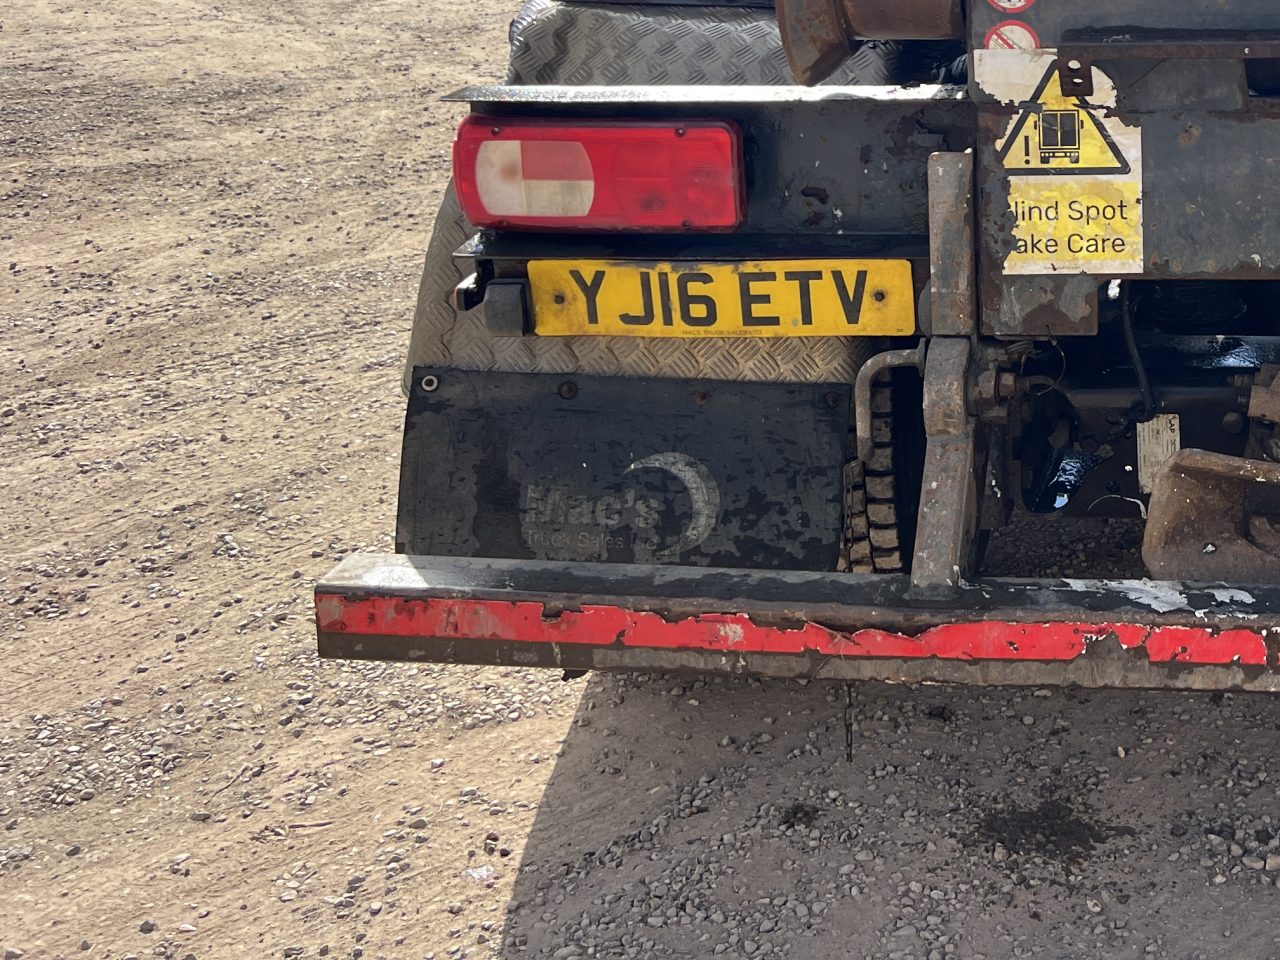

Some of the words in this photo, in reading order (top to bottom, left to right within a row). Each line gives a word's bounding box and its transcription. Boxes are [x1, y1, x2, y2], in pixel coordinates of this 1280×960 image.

[1014, 201, 1058, 221] lind
[1068, 200, 1128, 225] Spot
[1016, 234, 1058, 254] ake
[1067, 233, 1126, 253] Care
[569, 270, 718, 327] YJ16
[738, 270, 868, 327] ETV
[523, 486, 662, 528] Mac's
[528, 530, 570, 548] Truck
[578, 531, 624, 549] Sales
